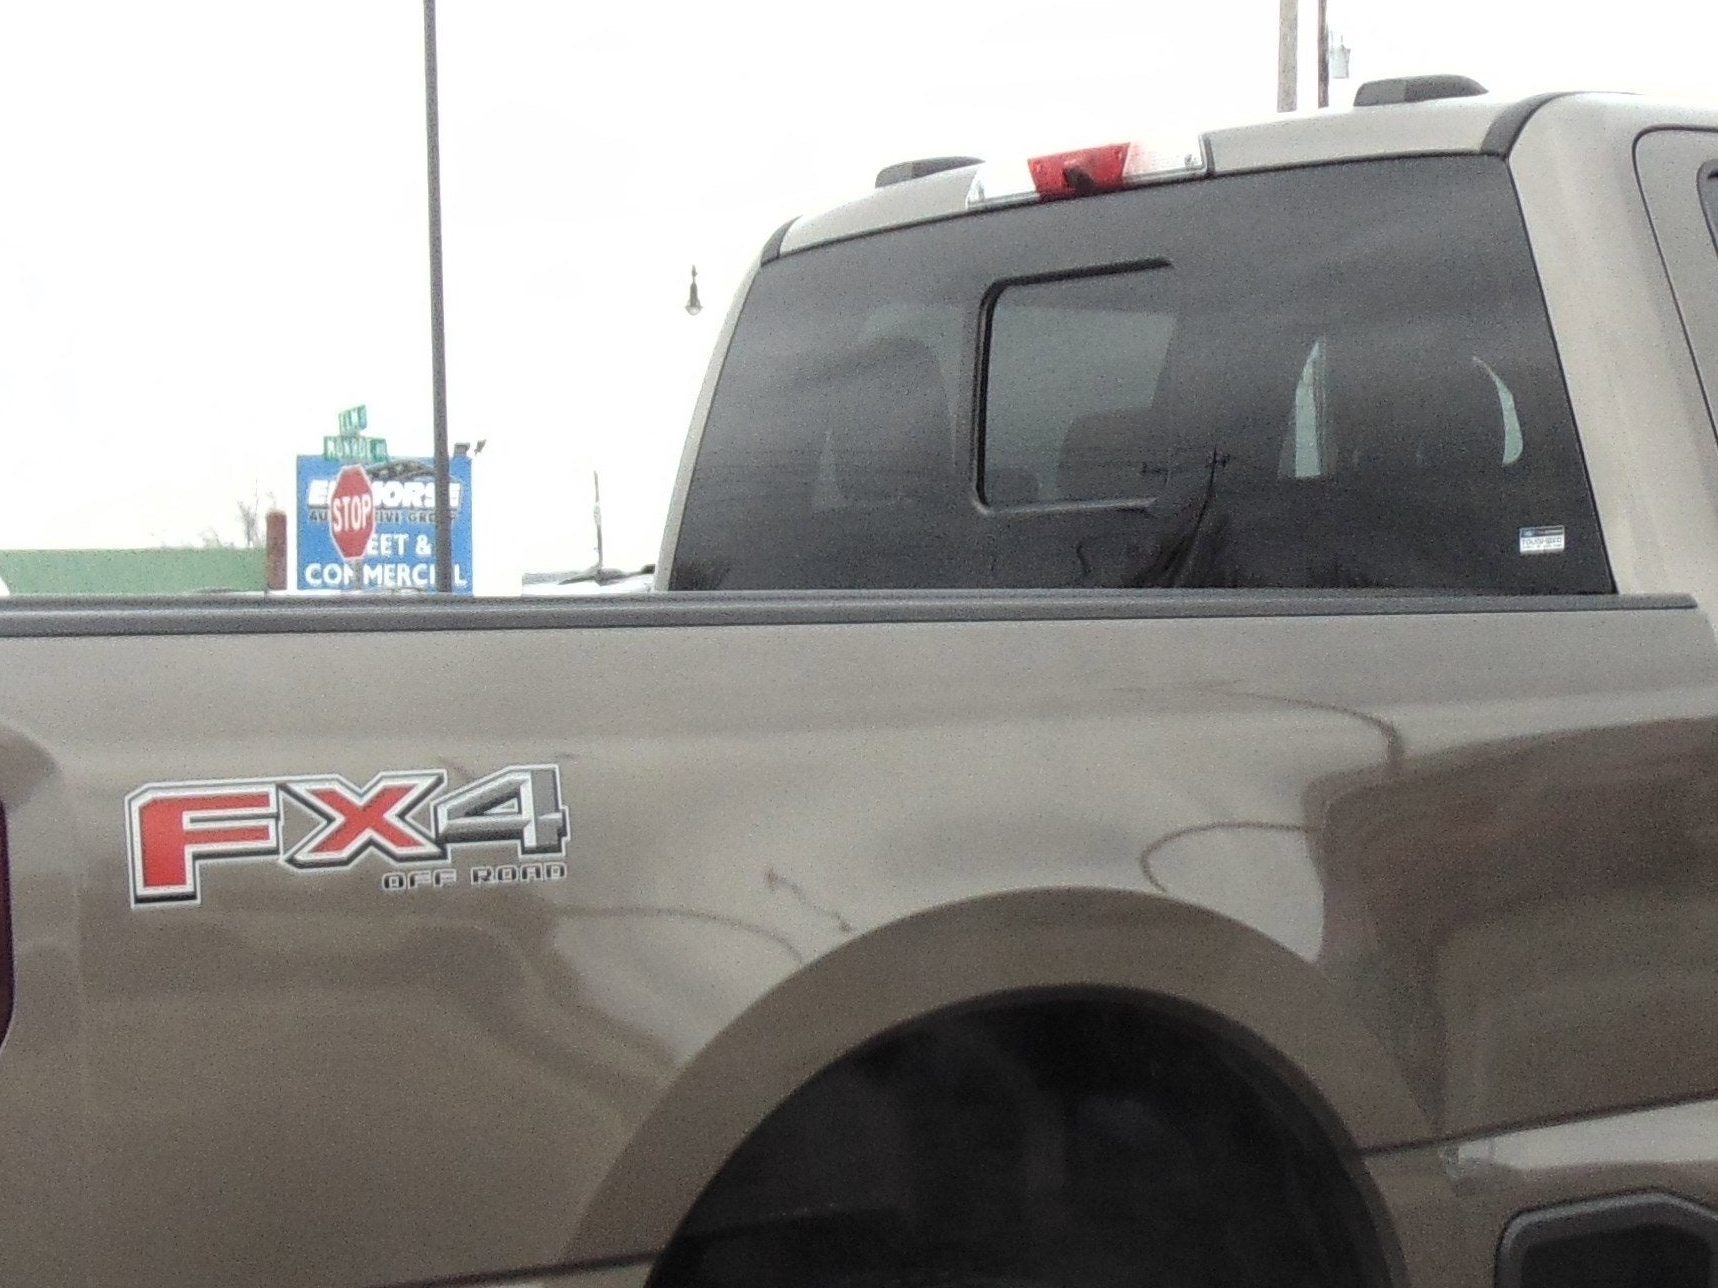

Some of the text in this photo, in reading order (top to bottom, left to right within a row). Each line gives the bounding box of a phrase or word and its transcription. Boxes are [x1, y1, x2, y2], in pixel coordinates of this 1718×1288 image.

[332, 494, 372, 533] STOP
[366, 533, 432, 556] EET &
[304, 563, 468, 587] COMMERCIL
[124, 763, 570, 910] FX4
[381, 861, 568, 892] OFF ROAD
